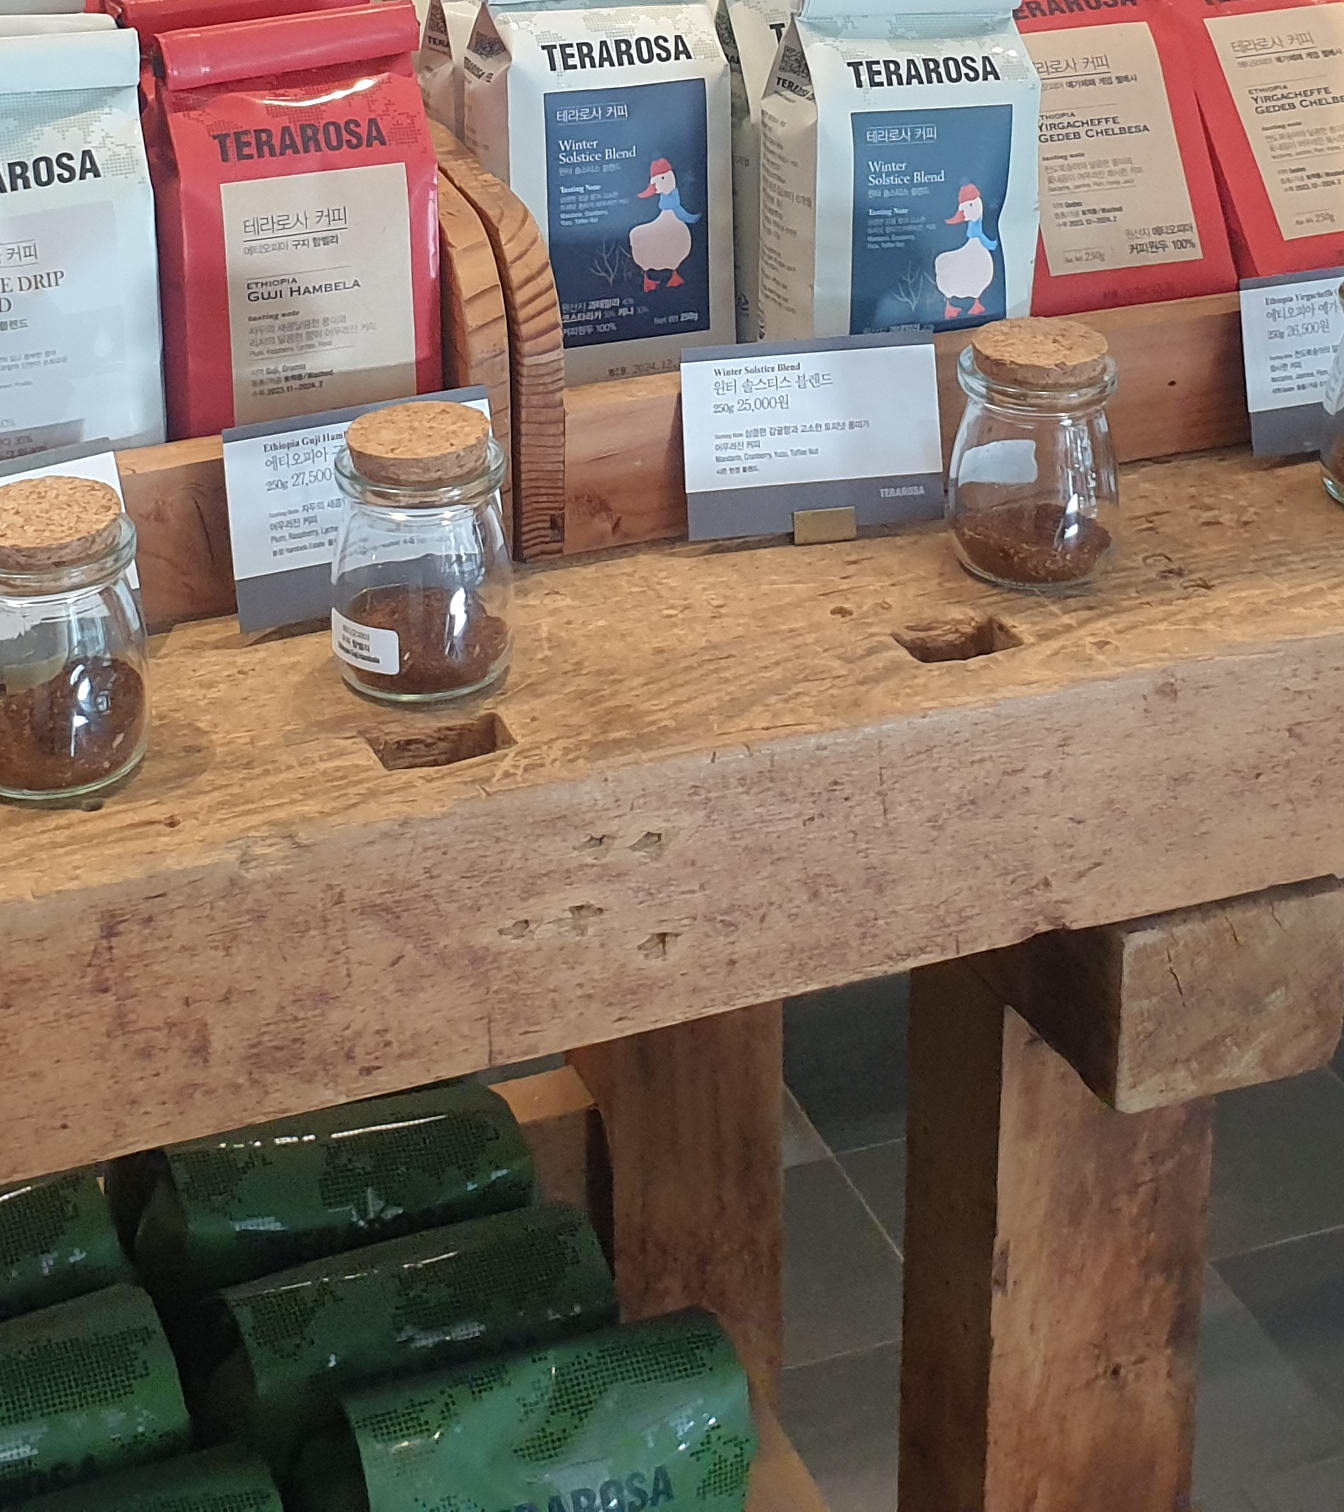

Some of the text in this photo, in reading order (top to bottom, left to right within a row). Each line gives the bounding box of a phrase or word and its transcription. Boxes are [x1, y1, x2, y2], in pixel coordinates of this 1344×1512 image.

[1231, 32, 1315, 52] 테라로사 커피
[542, 35, 693, 72] TERAROSA
[1083, 54, 1109, 69] 커피
[847, 55, 1000, 88] TERAROSA
[1248, 84, 1288, 95] ETHIOPIA
[1251, 87, 1332, 104] YIRGACHEFFE
[556, 104, 628, 123] 테라로사 커피
[1255, 104, 1296, 115] GEDEB
[1038, 116, 1119, 132] YIRGACHEFFE
[212, 118, 387, 163] TERAROSA
[866, 126, 937, 142] 테라로사 커피
[1038, 125, 1150, 143] GEDEB CHELBESA
[559, 139, 598, 151] Winter
[559, 146, 636, 164] Solstice Blend
[868, 161, 906, 172] Winter
[868, 171, 945, 186] Solstice Blend
[243, 206, 347, 236] 테라로사 커피
[7, 242, 38, 262] 커피
[1128, 238, 1196, 254] 커피원두 100%
[18, 270, 64, 293] DRIP
[247, 278, 297, 289] ETHIOPIA
[290, 279, 361, 297] HAMBELA
[1266, 305, 1315, 321] 에티오피아
[1287, 320, 1330, 337] 26,500원
[714, 363, 801, 377] Winter Solstice Blend
[713, 373, 833, 395] 윈터 솔스티스 블렌드
[713, 395, 789, 414] 250g 25,000원
[263, 435, 321, 452] Ethiopia Guji
[715, 440, 744, 451] 어우러진
[265, 447, 328, 471] 에티오피아
[880, 486, 925, 498] TERAROSA
